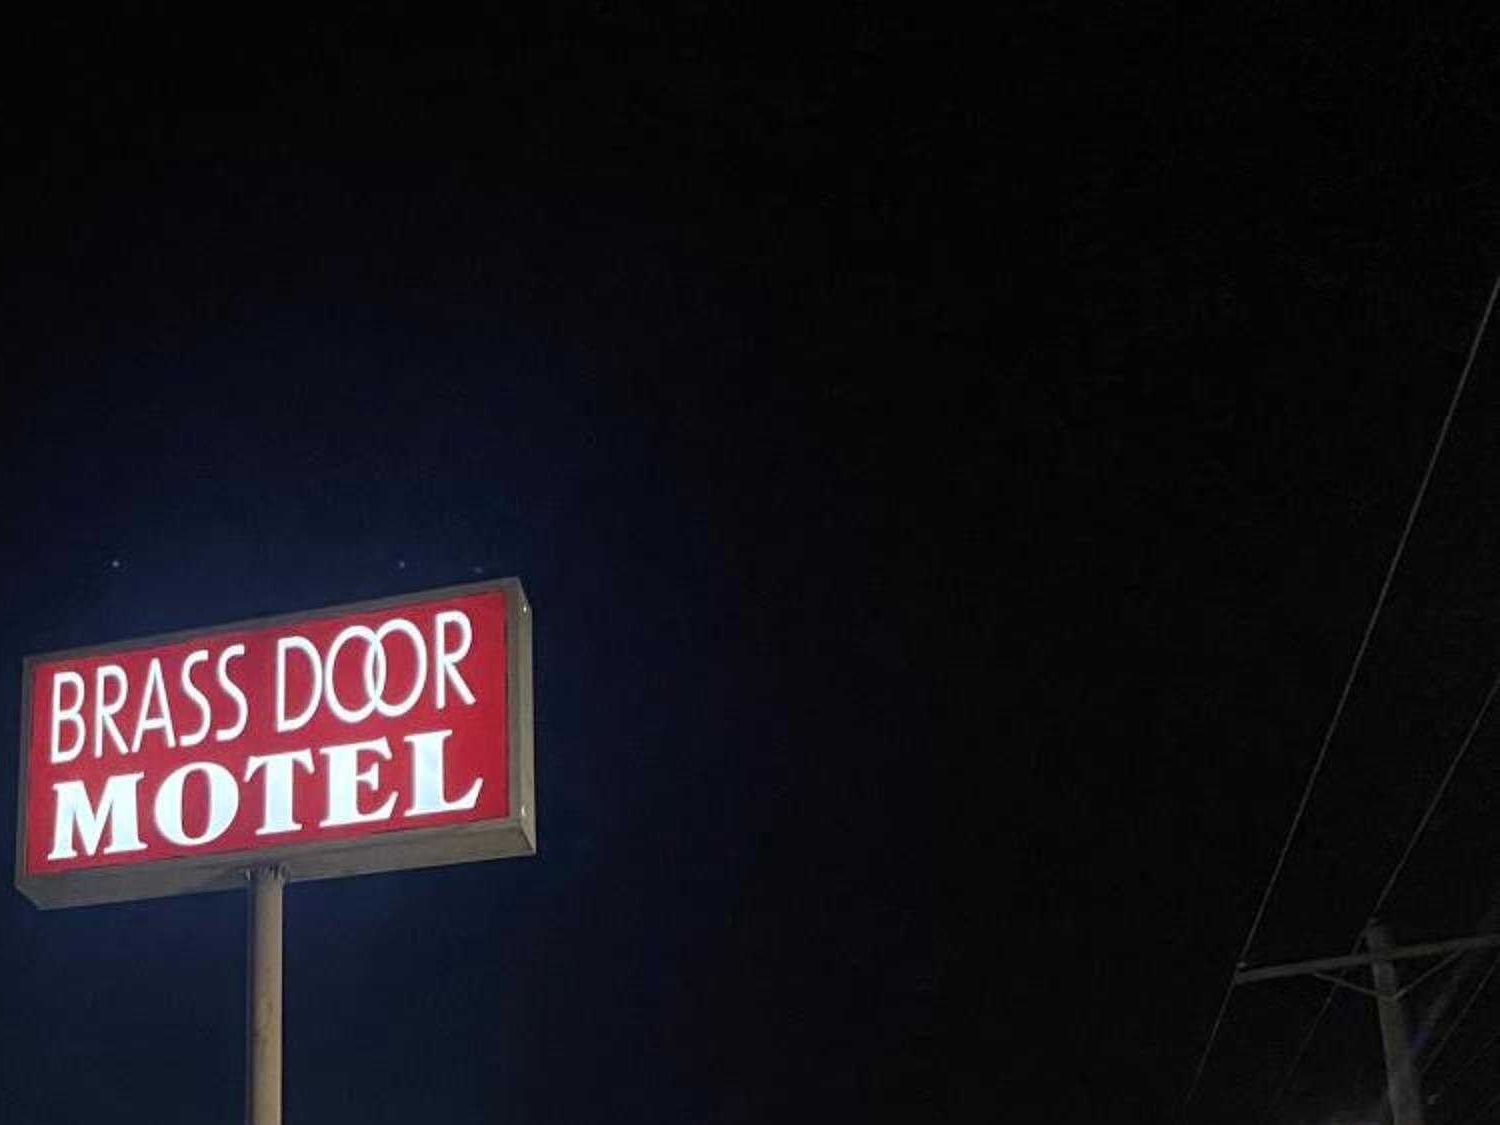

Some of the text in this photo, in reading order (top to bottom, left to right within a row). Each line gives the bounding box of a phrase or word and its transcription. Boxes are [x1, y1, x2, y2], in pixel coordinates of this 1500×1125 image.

[49, 610, 476, 764] BRASS DOOR
[47, 728, 484, 861] MOTEL
